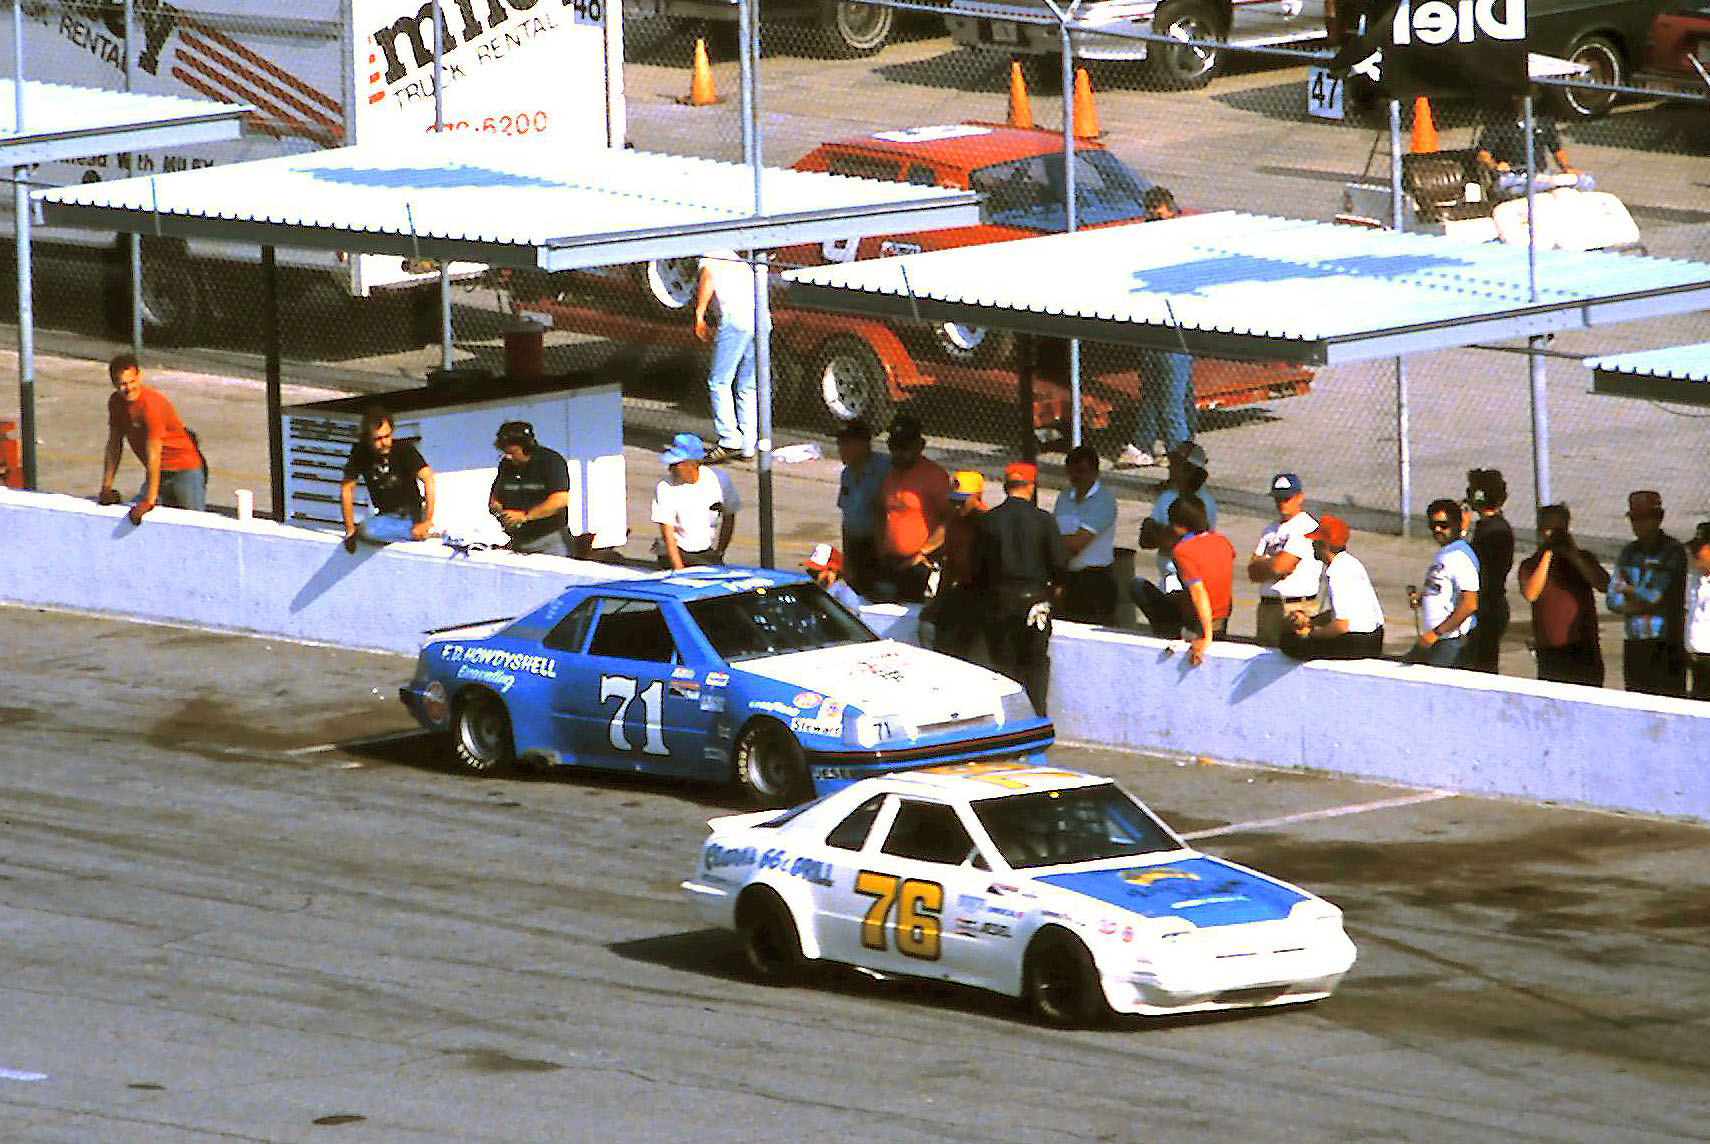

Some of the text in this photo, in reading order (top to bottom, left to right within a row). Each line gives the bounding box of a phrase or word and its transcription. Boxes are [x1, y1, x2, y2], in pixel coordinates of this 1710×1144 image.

[1312, 70, 1340, 109] 47
[599, 673, 671, 757] 71
[854, 868, 944, 962] 76
